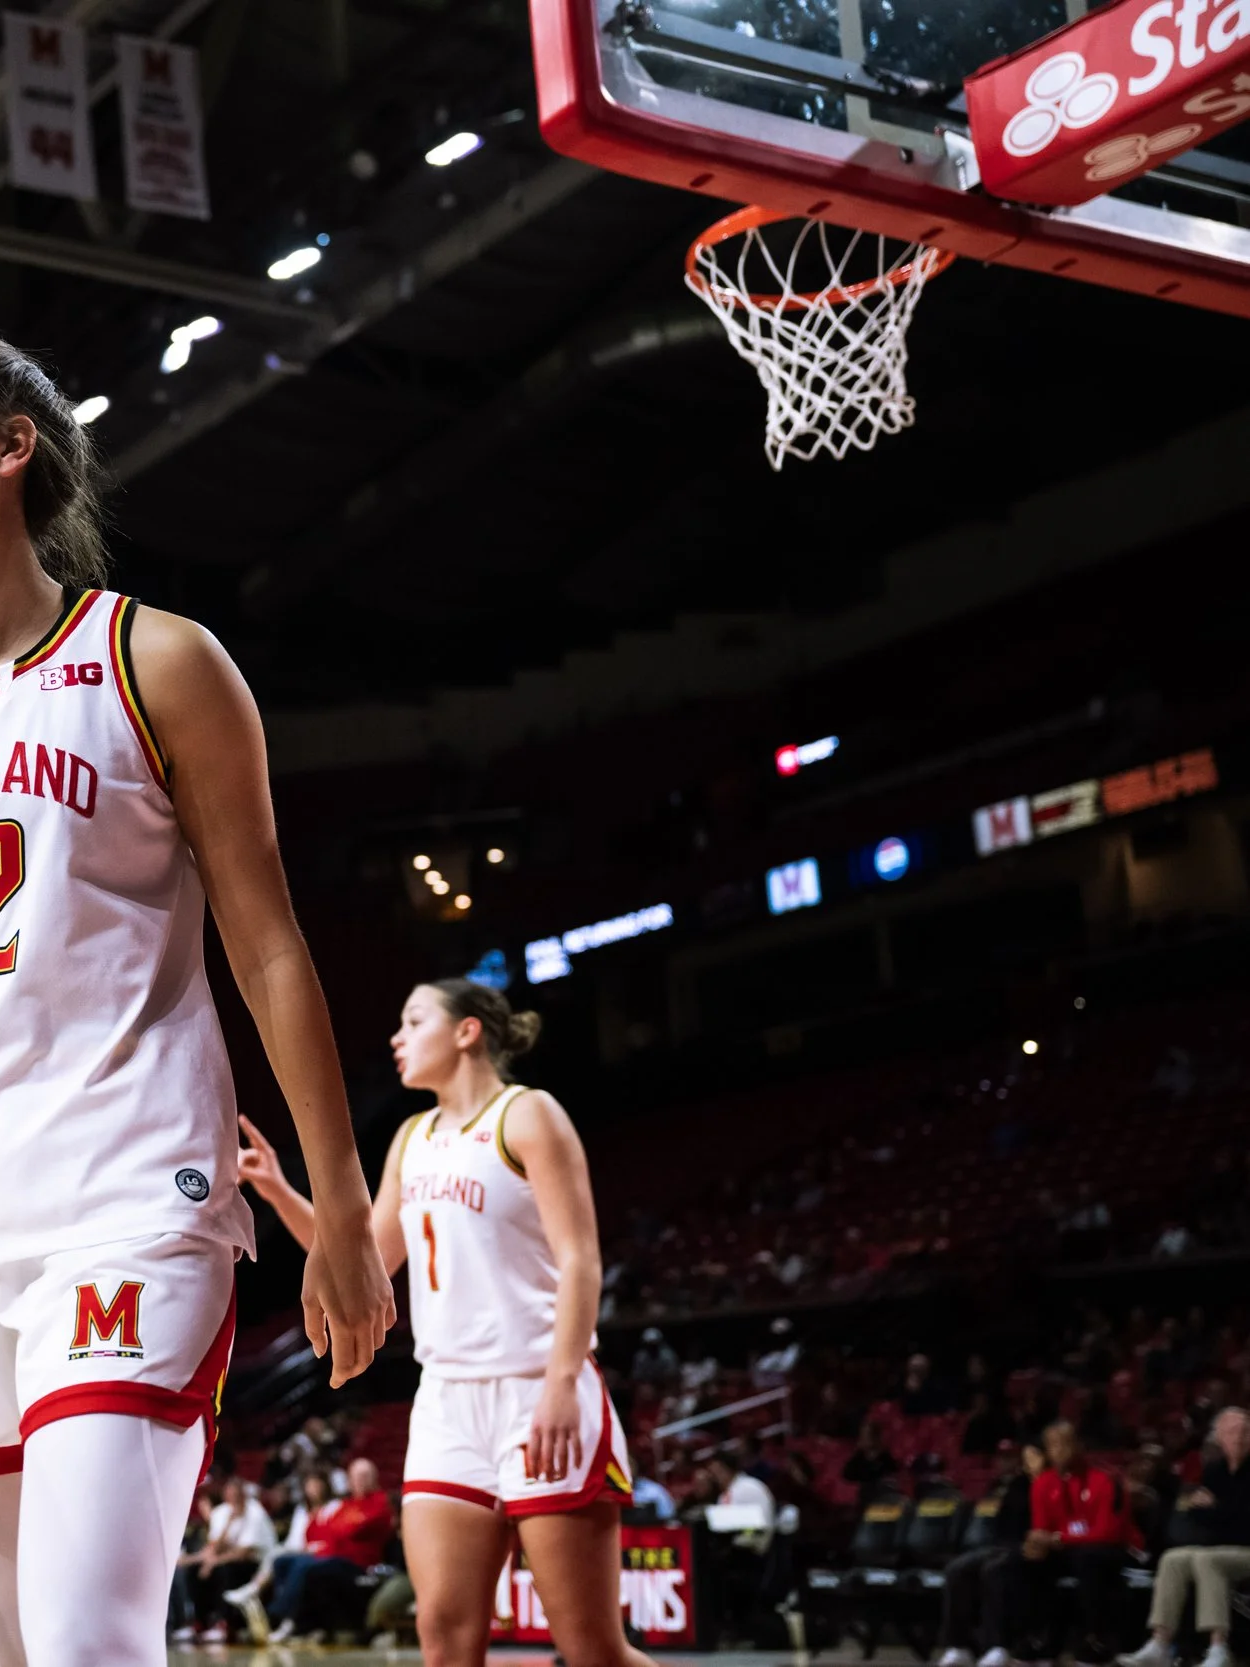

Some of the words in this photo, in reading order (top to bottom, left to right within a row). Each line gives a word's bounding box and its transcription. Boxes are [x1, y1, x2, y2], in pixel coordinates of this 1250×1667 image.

[40, 662, 103, 691] BIG
[422, 1210, 440, 1292] 1
[68, 1280, 146, 1350] M
